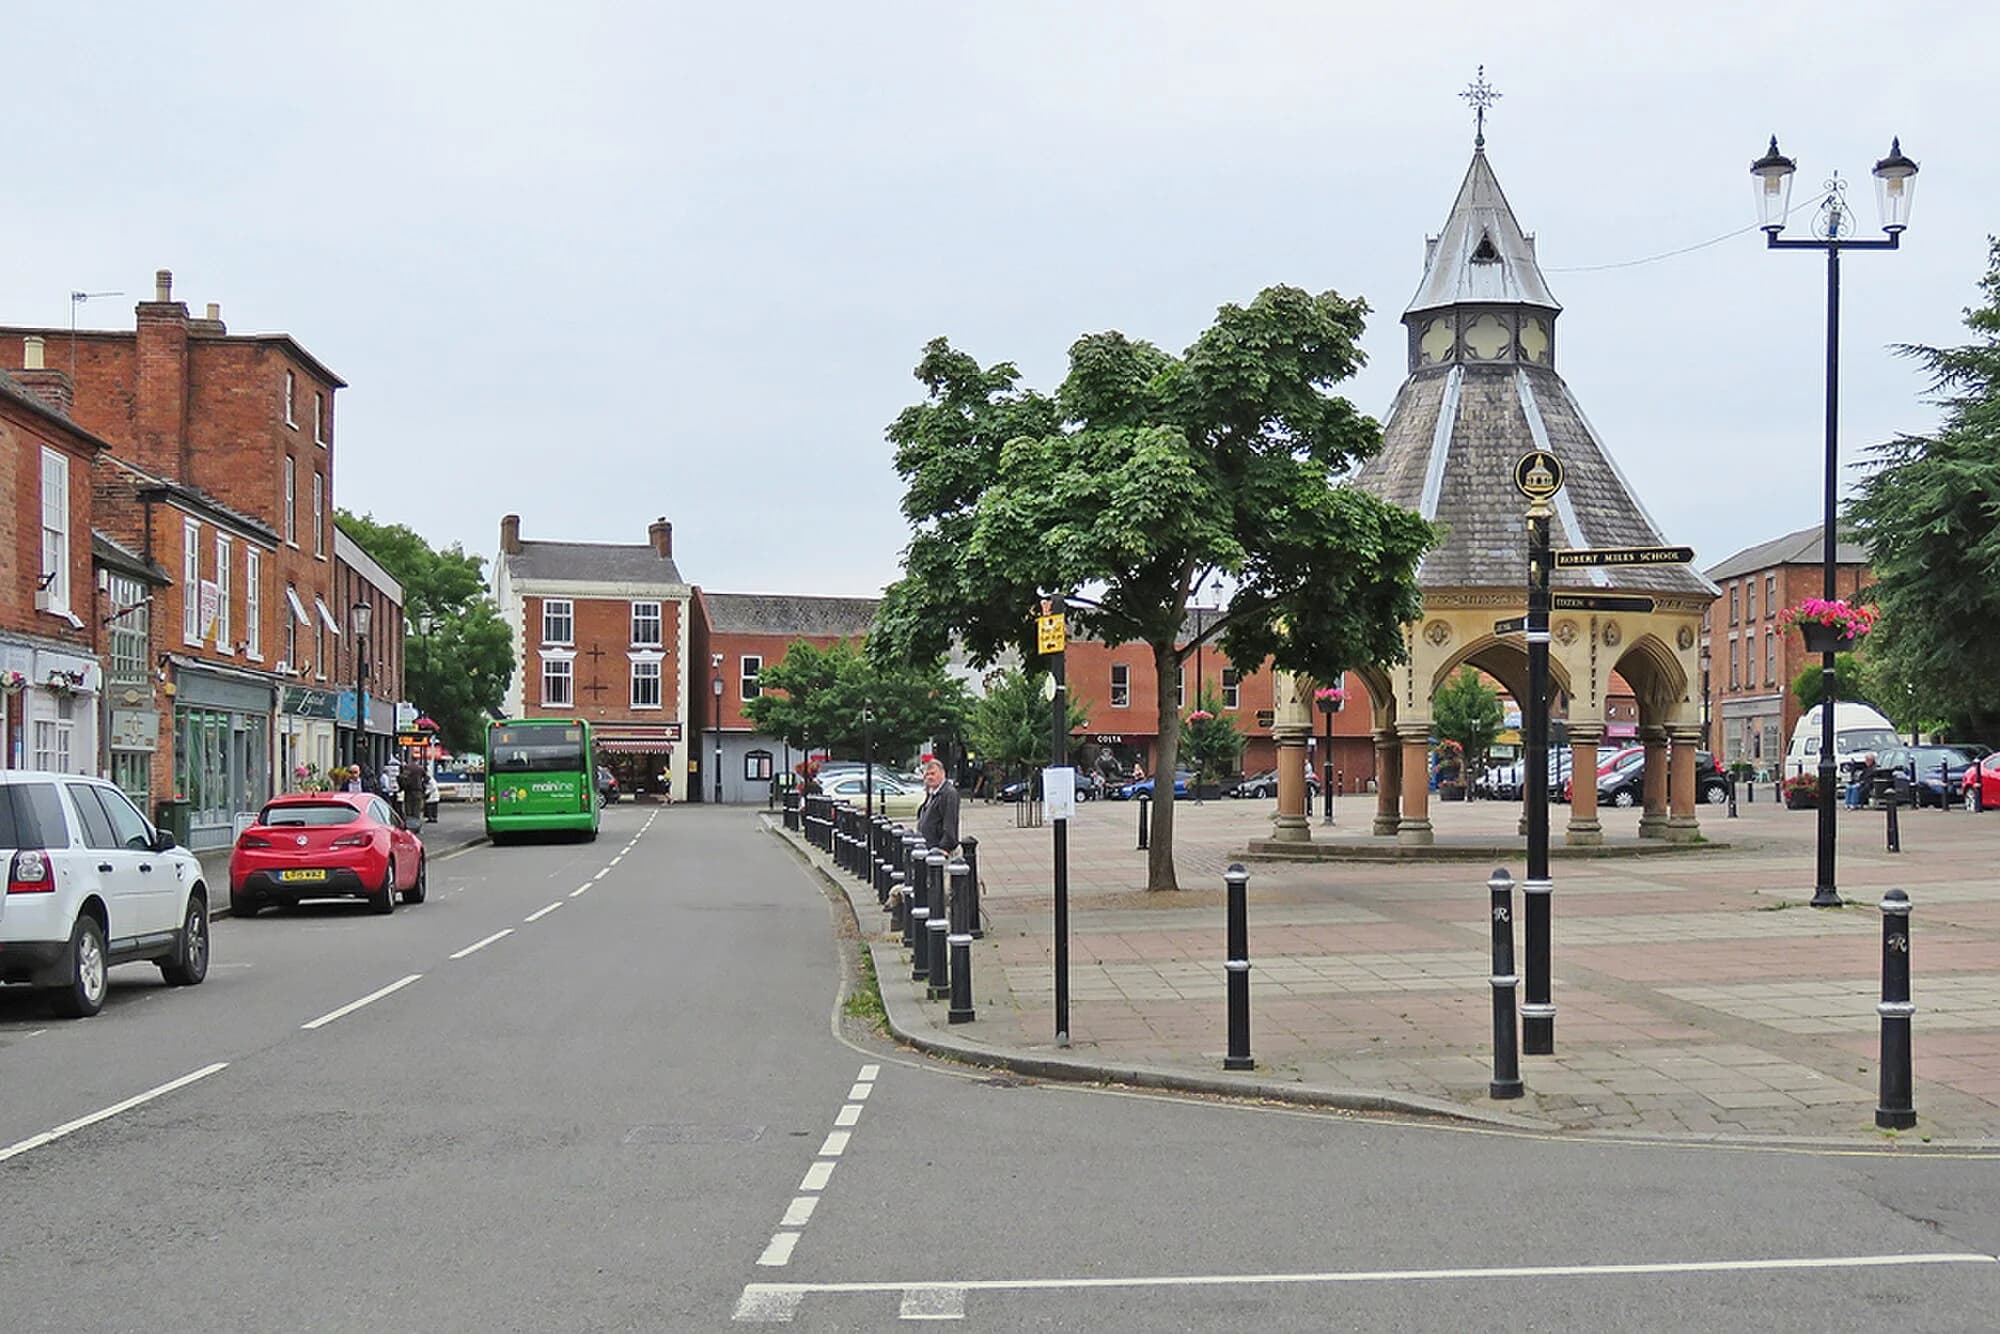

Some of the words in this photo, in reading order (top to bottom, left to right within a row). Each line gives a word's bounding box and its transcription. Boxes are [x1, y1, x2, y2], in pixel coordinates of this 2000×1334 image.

[1560, 554, 1598, 564] ROBERT
[1604, 553, 1634, 562] MILES
[1639, 551, 1680, 561] SCHOOL
